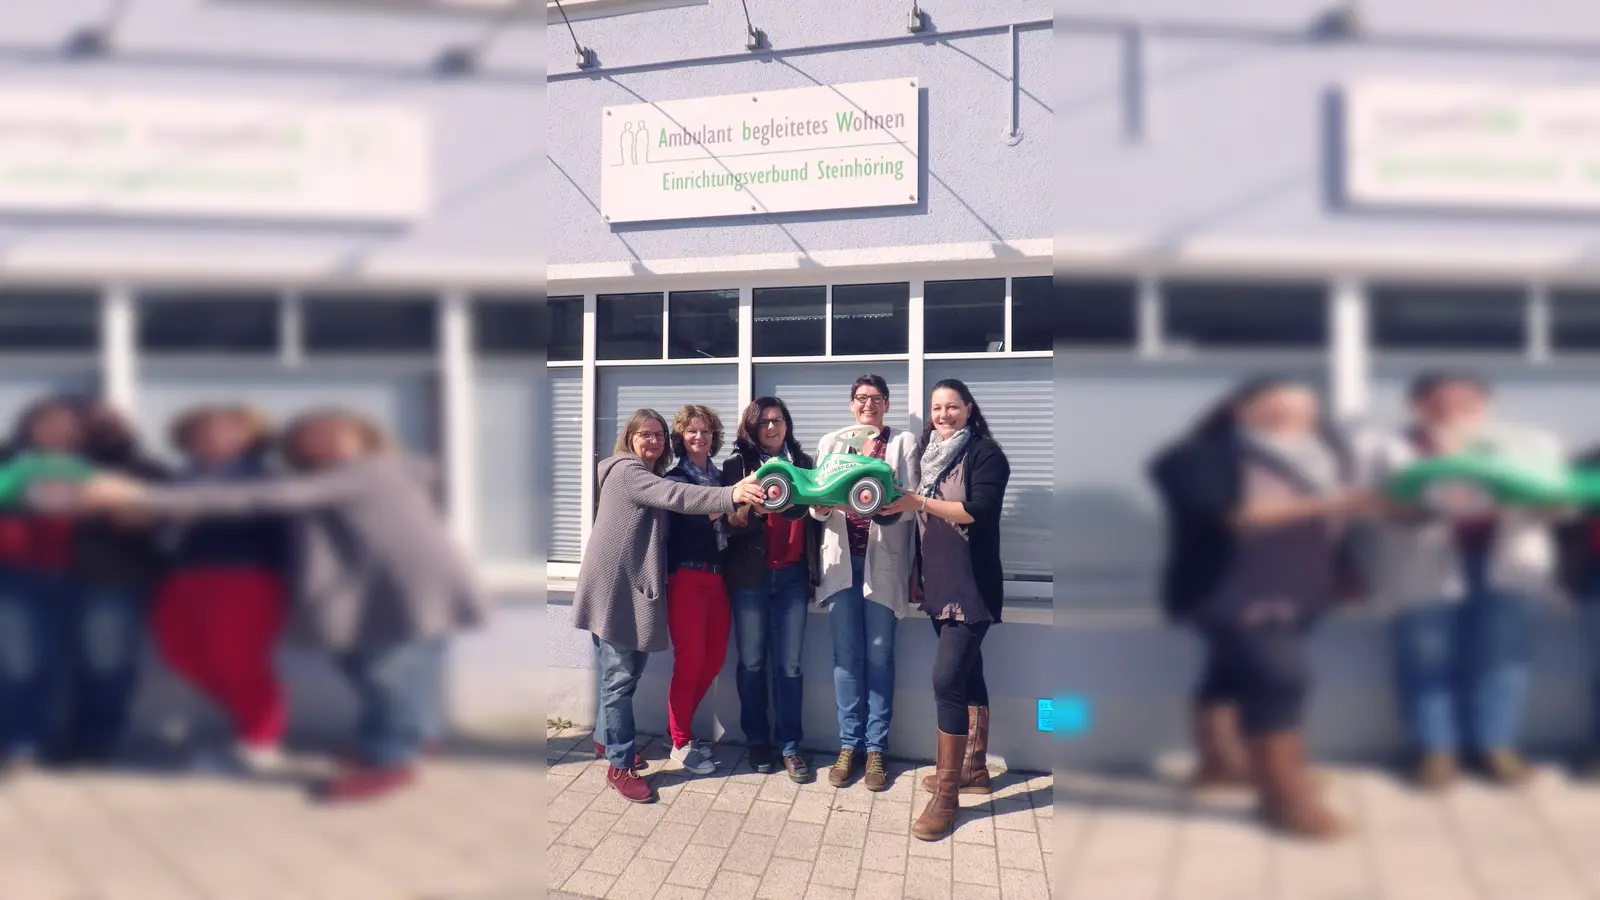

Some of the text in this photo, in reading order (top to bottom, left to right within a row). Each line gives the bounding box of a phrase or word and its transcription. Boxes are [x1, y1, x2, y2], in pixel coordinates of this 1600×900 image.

[658, 110, 905, 148] Ambulant begleitetes Wohnen
[662, 156, 904, 192] Einrichtungsverbund Steinhöring
